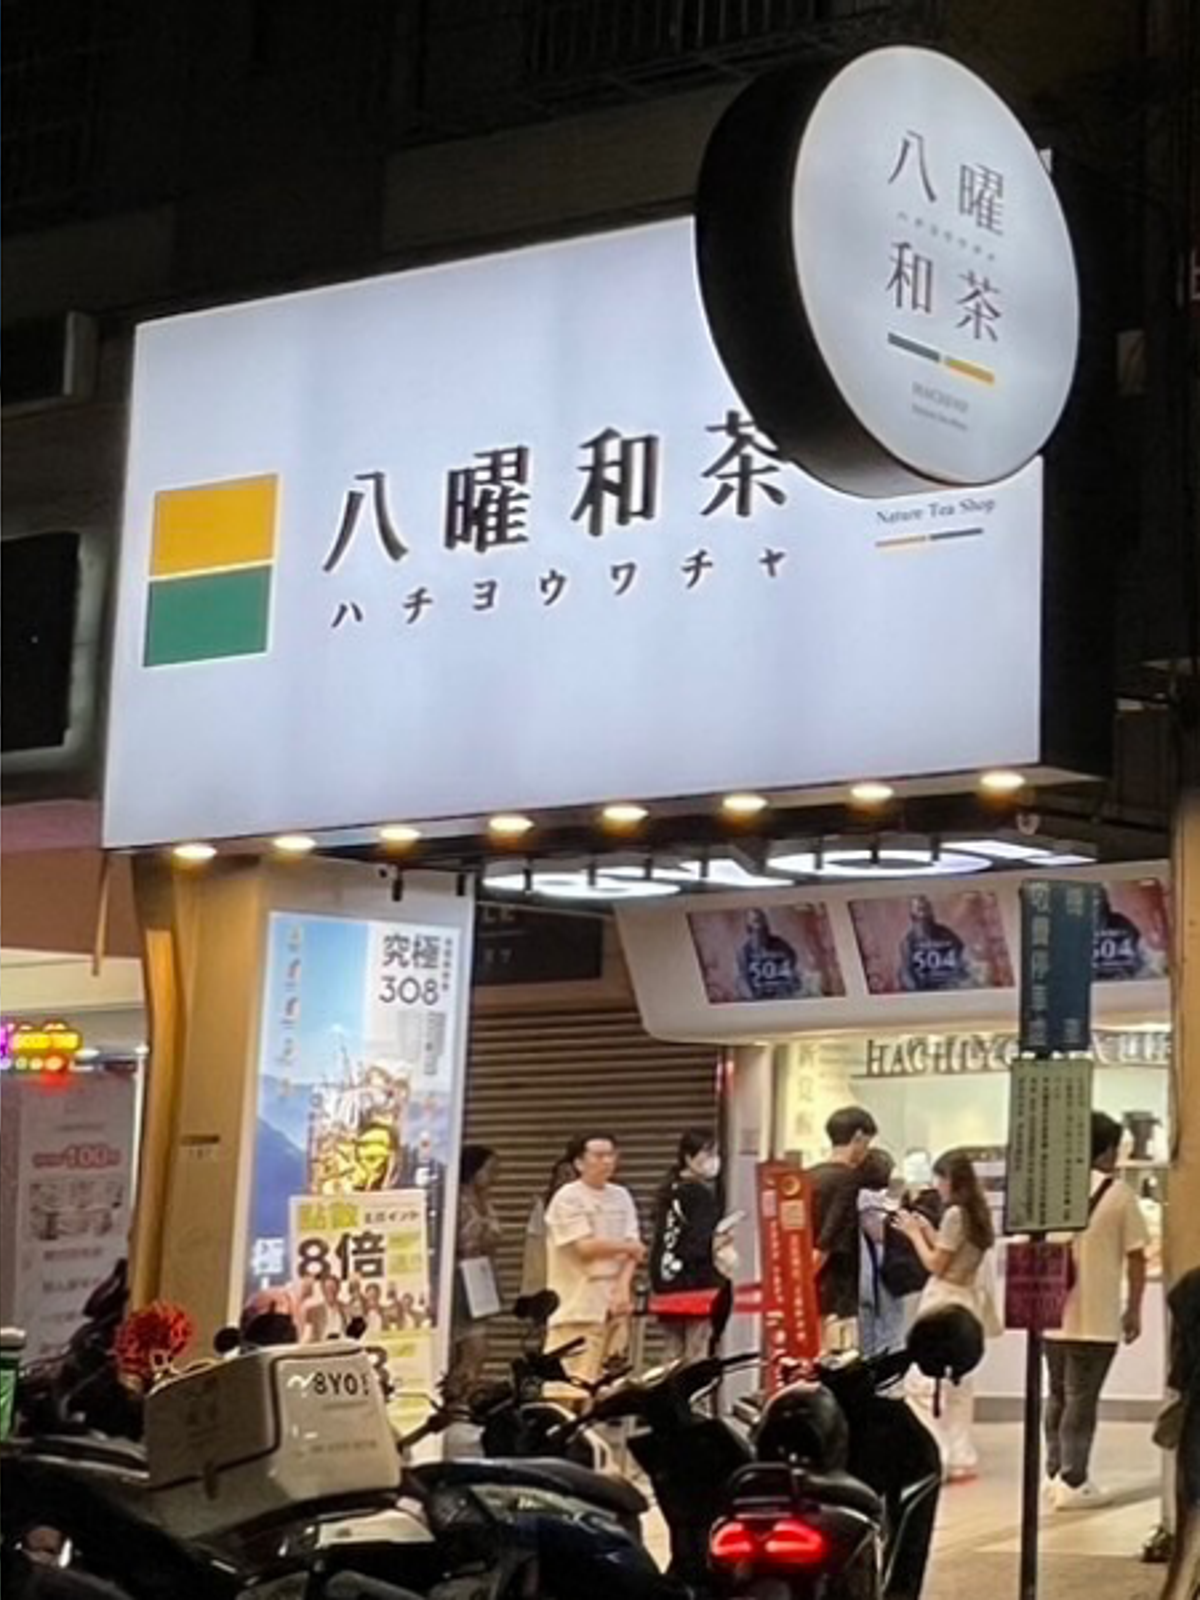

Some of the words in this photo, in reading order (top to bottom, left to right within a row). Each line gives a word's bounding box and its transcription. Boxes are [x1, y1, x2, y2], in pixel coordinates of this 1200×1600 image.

[322, 409, 788, 573] 八曜和茶
[928, 502, 955, 518] Tea
[382, 933, 441, 970] 究極
[379, 975, 439, 1005] 308
[298, 1230, 386, 1281] 8倍
